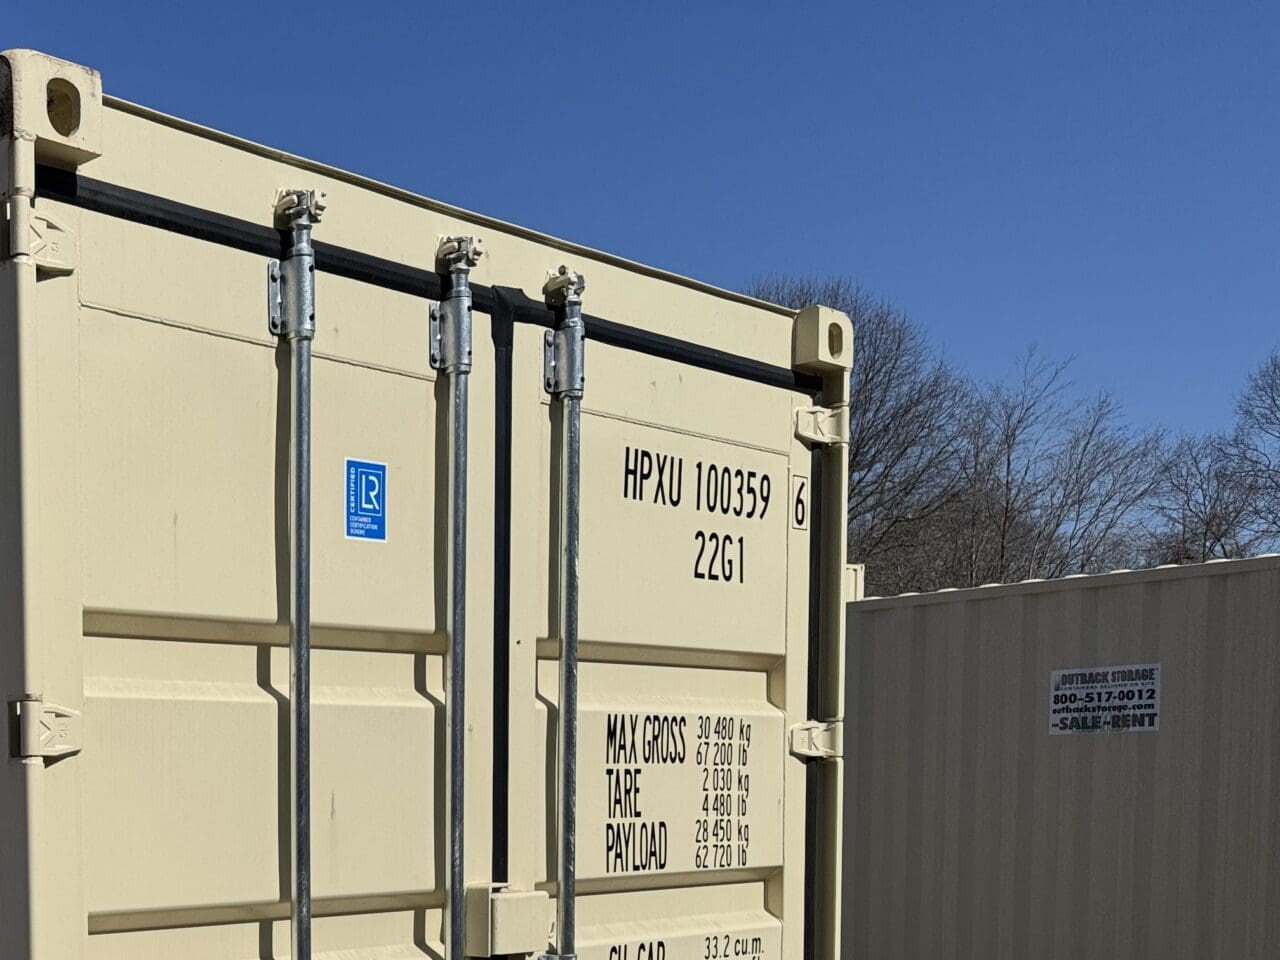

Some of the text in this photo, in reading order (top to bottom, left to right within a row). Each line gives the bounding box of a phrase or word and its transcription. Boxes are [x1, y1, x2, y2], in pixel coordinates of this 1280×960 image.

[623, 446, 805, 526] HPXU 100359 6
[694, 530, 744, 584] 22G1
[1061, 668, 1155, 686] OUTBACK STORAGE
[1052, 703, 1155, 715] outbackstorage.com
[1053, 688, 1156, 705] 800-517-0012
[697, 716, 751, 748] 30 480 kg
[1059, 715, 1101, 731] SALE
[1111, 712, 1158, 729] RENT
[606, 714, 687, 764] MAX GROSS
[696, 743, 748, 766] 67 200 lb
[606, 768, 642, 818] TARE
[702, 768, 749, 799] 2 030 kg
[702, 793, 746, 817] 4 480 lb
[606, 821, 668, 873] PAYLOAD
[695, 819, 749, 848] 28 450 kg
[695, 844, 747, 868] 62 720 lb
[704, 934, 730, 960] 33.2
